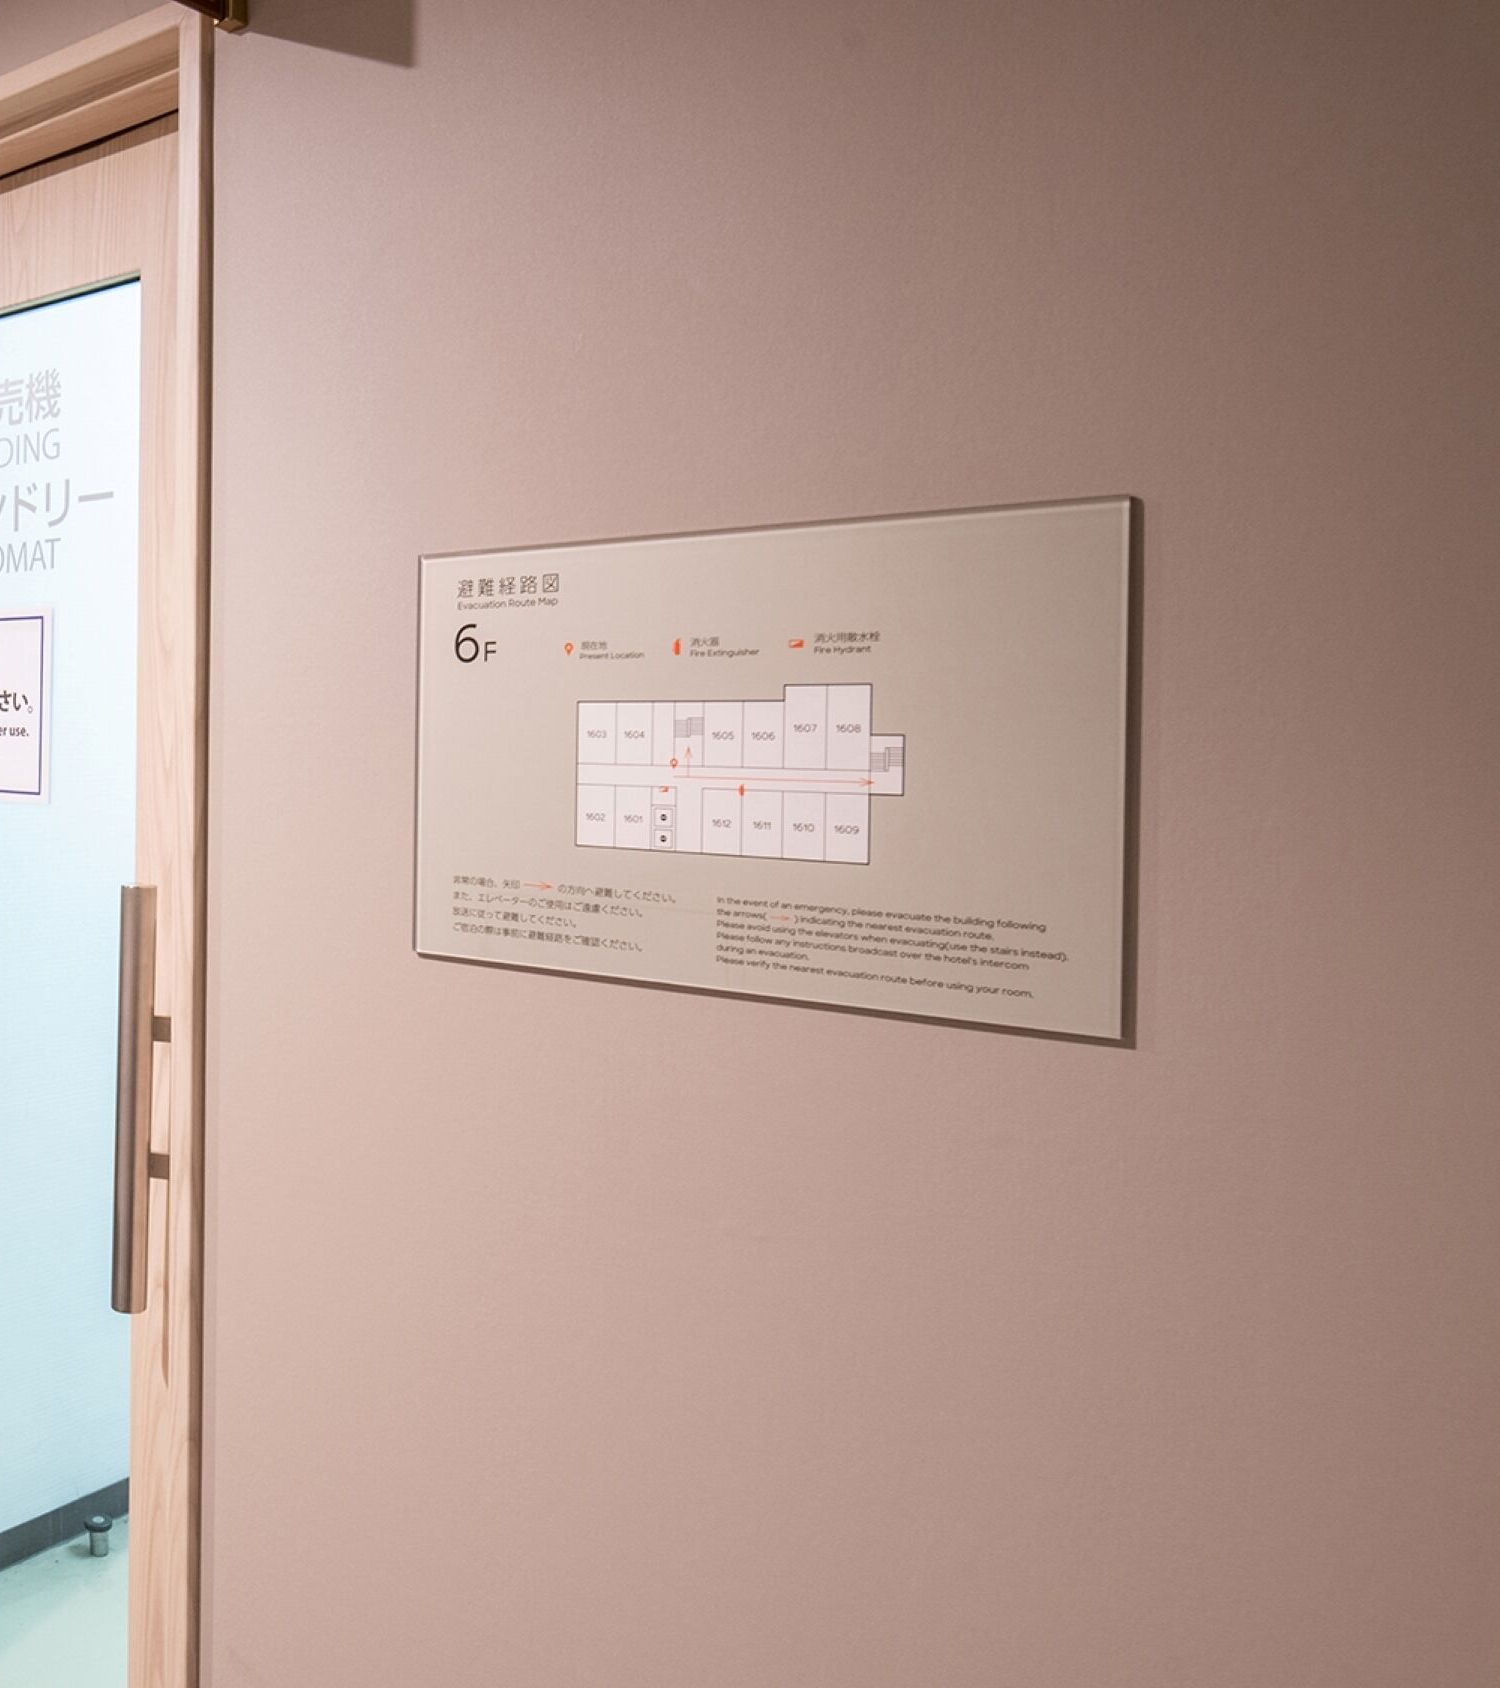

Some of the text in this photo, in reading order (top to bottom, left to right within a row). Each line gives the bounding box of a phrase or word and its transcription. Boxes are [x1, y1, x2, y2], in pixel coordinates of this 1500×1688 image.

[457, 573, 559, 598] 避難経路図
[457, 597, 558, 610] Evacuation Route Map
[581, 642, 607, 650] 現在地
[690, 636, 720, 647] 消火器
[611, 651, 644, 659] Location
[690, 648, 759, 658] Fire Extinguisher
[814, 645, 872, 655] Fire Hydrant
[9, 726, 29, 737] use.
[794, 723, 817, 733] 1607
[836, 723, 862, 733] 1608
[587, 730, 607, 738] 1603
[624, 730, 645, 739] 1604
[712, 731, 734, 740] 1605
[752, 731, 775, 741] 1606
[586, 812, 605, 822] 1602
[624, 814, 643, 823] 1601
[712, 819, 731, 828] 1612
[753, 821, 771, 830] 1611
[793, 823, 814, 833] 1610
[834, 825, 859, 835] 1609
[743, 900, 768, 908] event
[794, 904, 849, 915] emergency,
[851, 908, 883, 918] please
[886, 912, 931, 922] evacuate
[934, 914, 950, 923] the
[953, 916, 994, 928] building
[997, 919, 1046, 933] following
[717, 908, 731, 916] the
[847, 920, 862, 928] the
[865, 921, 903, 933] nearest
[905, 925, 961, 937] evacuation
[963, 931, 994, 940] route.
[717, 920, 744, 930] Please
[747, 922, 771, 932] avoid
[772, 925, 796, 935] using
[798, 927, 813, 936] the
[815, 929, 858, 941] elevators
[861, 933, 890, 943] when
[970, 944, 988, 953] the
[990, 946, 1018, 956] stairs
[1021, 948, 1069, 962] instead).
[716, 944, 744, 954] during
[758, 948, 809, 960] evacuation.
[717, 932, 744, 941] Please
[747, 935, 772, 945] follow
[775, 938, 790, 948] any
[793, 939, 846, 952] instructions
[849, 944, 897, 957] broadcast
[925, 953, 942, 962] the
[980, 958, 1029, 970] intercom
[716, 956, 1034, 999] Please verify the nearest evacuation route before using your room.
